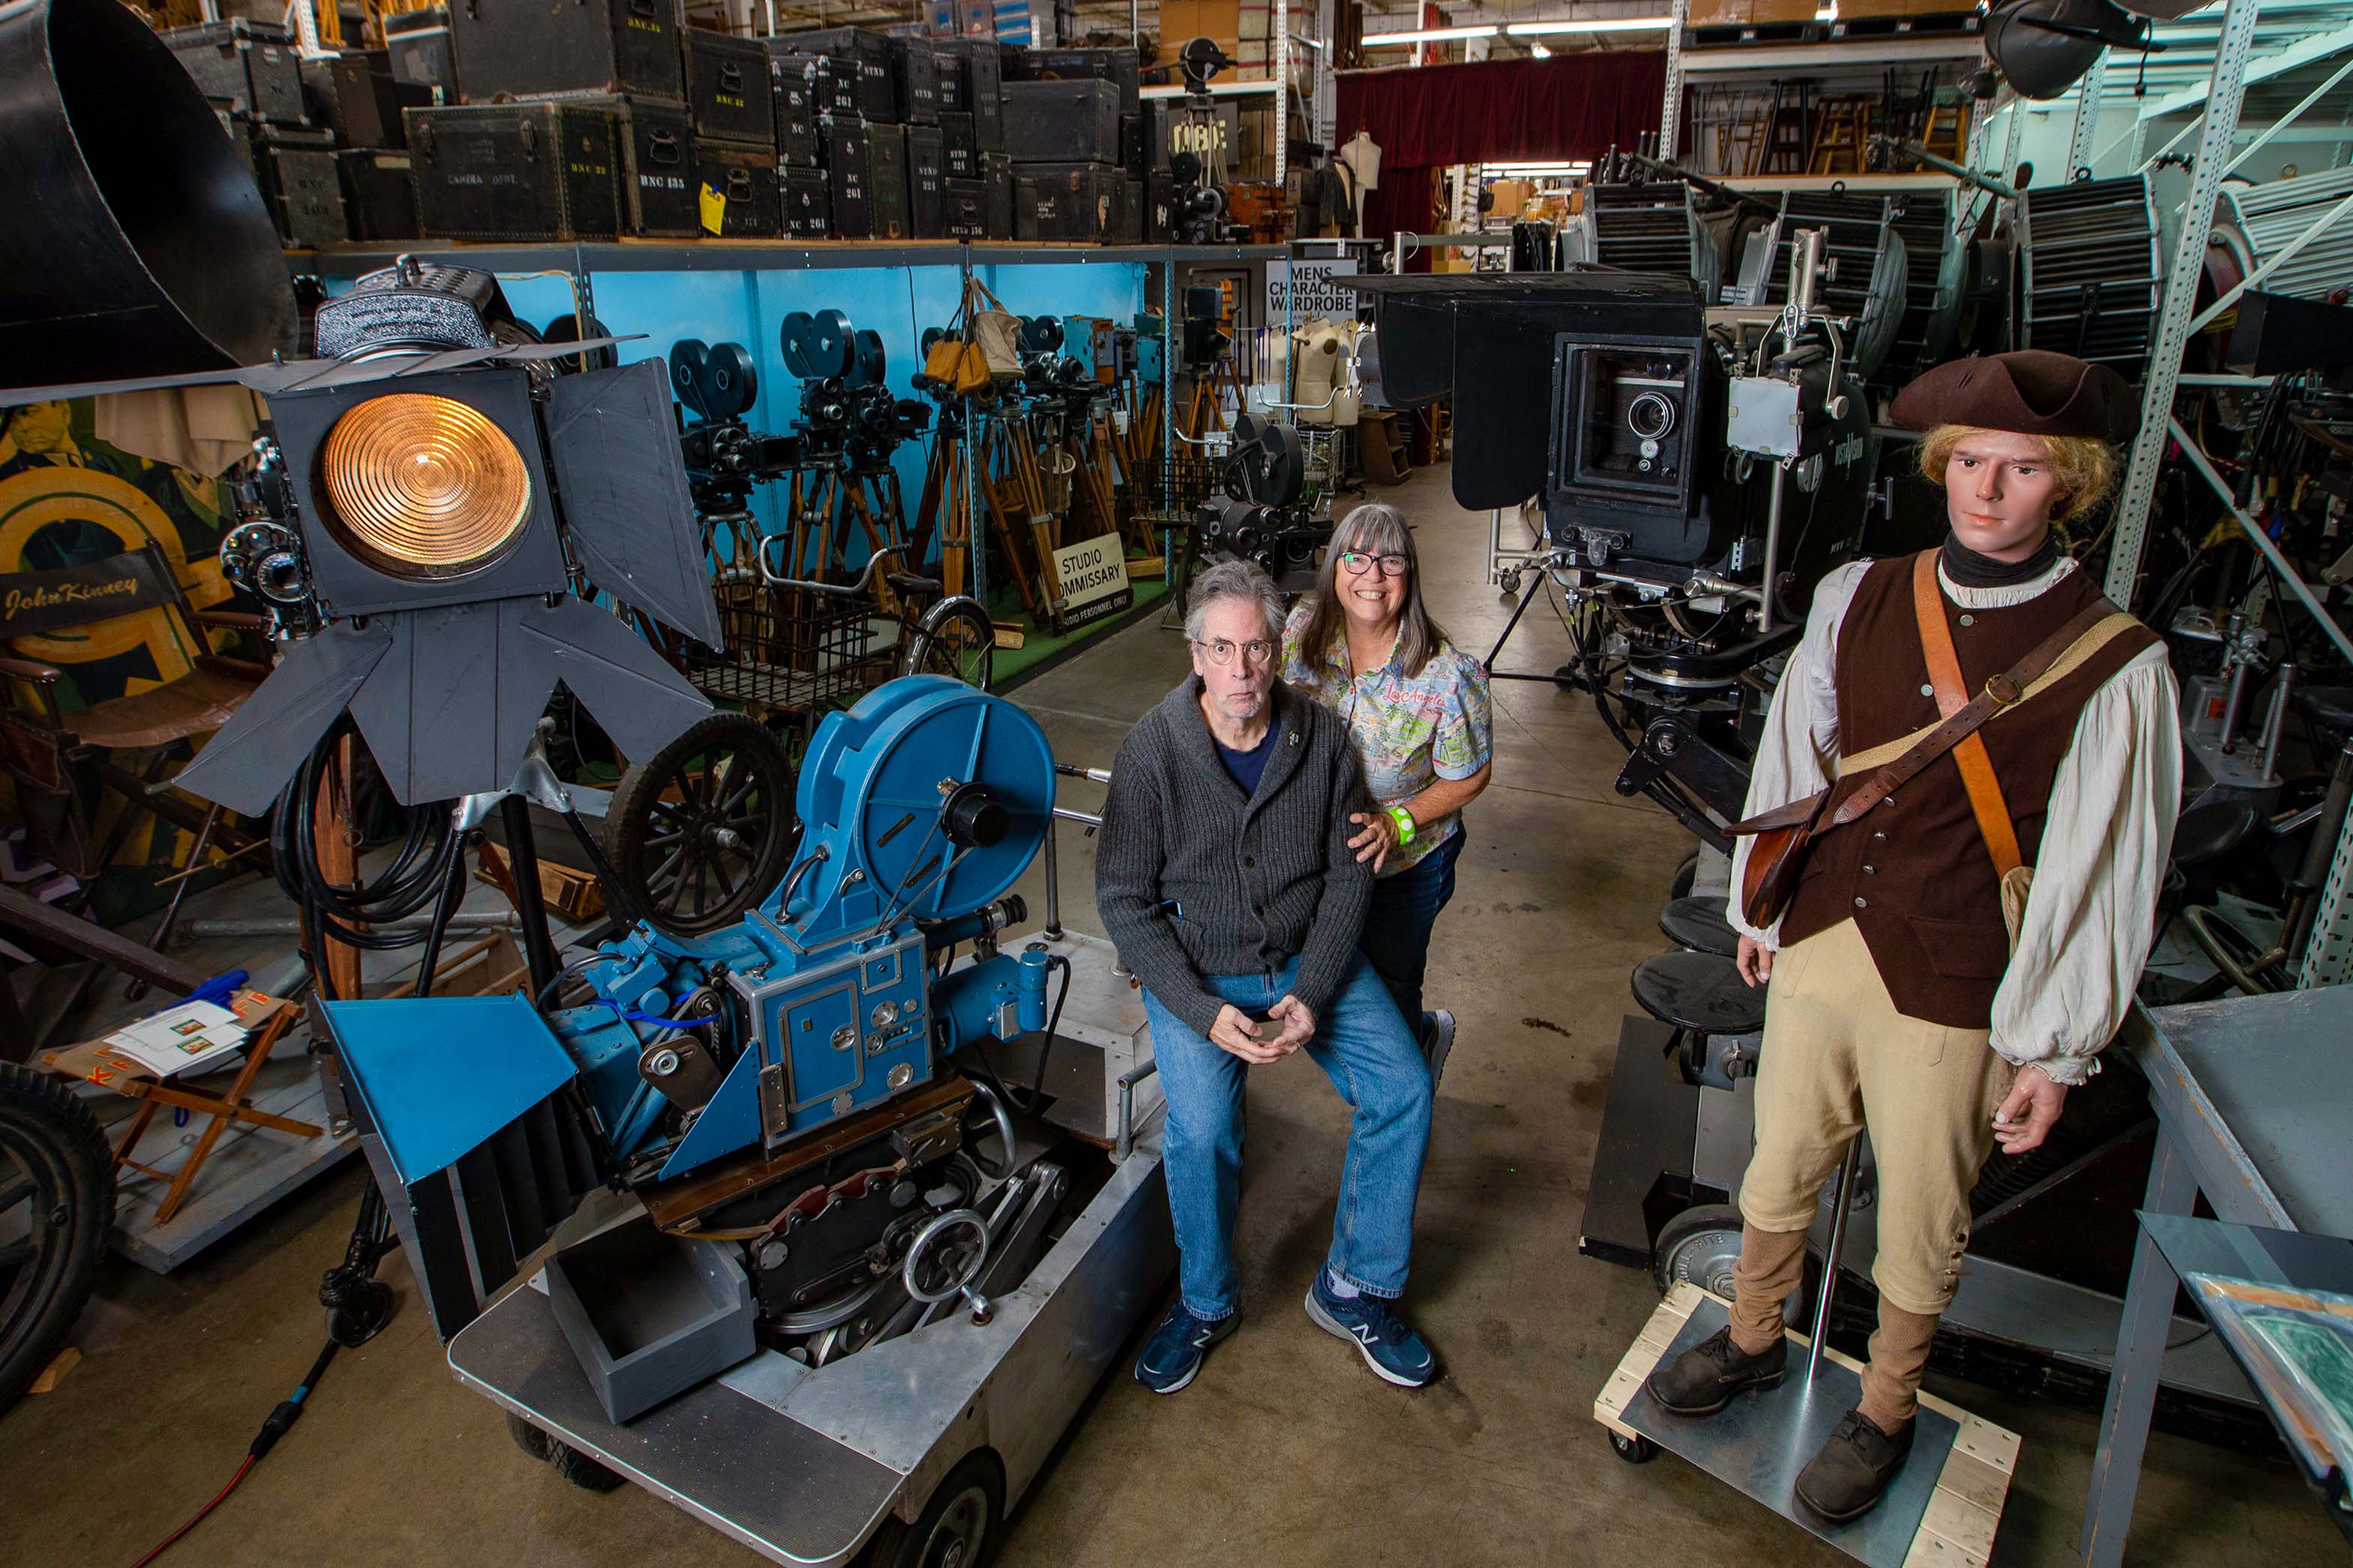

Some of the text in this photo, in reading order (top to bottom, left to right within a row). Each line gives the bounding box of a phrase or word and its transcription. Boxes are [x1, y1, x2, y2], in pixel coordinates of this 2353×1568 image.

[864, 66, 885, 78] STND
[837, 78, 850, 90] NC
[914, 89, 933, 100] STND
[835, 95, 852, 109] 261
[792, 122, 804, 134] NC
[949, 149, 967, 159] STND
[918, 167, 937, 177] STND
[447, 173, 483, 185] CAMERA
[639, 173, 665, 188] BNC
[846, 173, 858, 185] NC
[846, 188, 861, 200] 261
[789, 217, 825, 230] NC 261
[1291, 266, 1332, 281] MENS
[1062, 548, 1101, 574] STUDIO
[1059, 563, 1120, 598] OMMISSARY
[5, 578, 138, 621] John Kinney
[1080, 601, 1113, 620] PERSONNEL
[1113, 595, 1128, 608] ONLY
